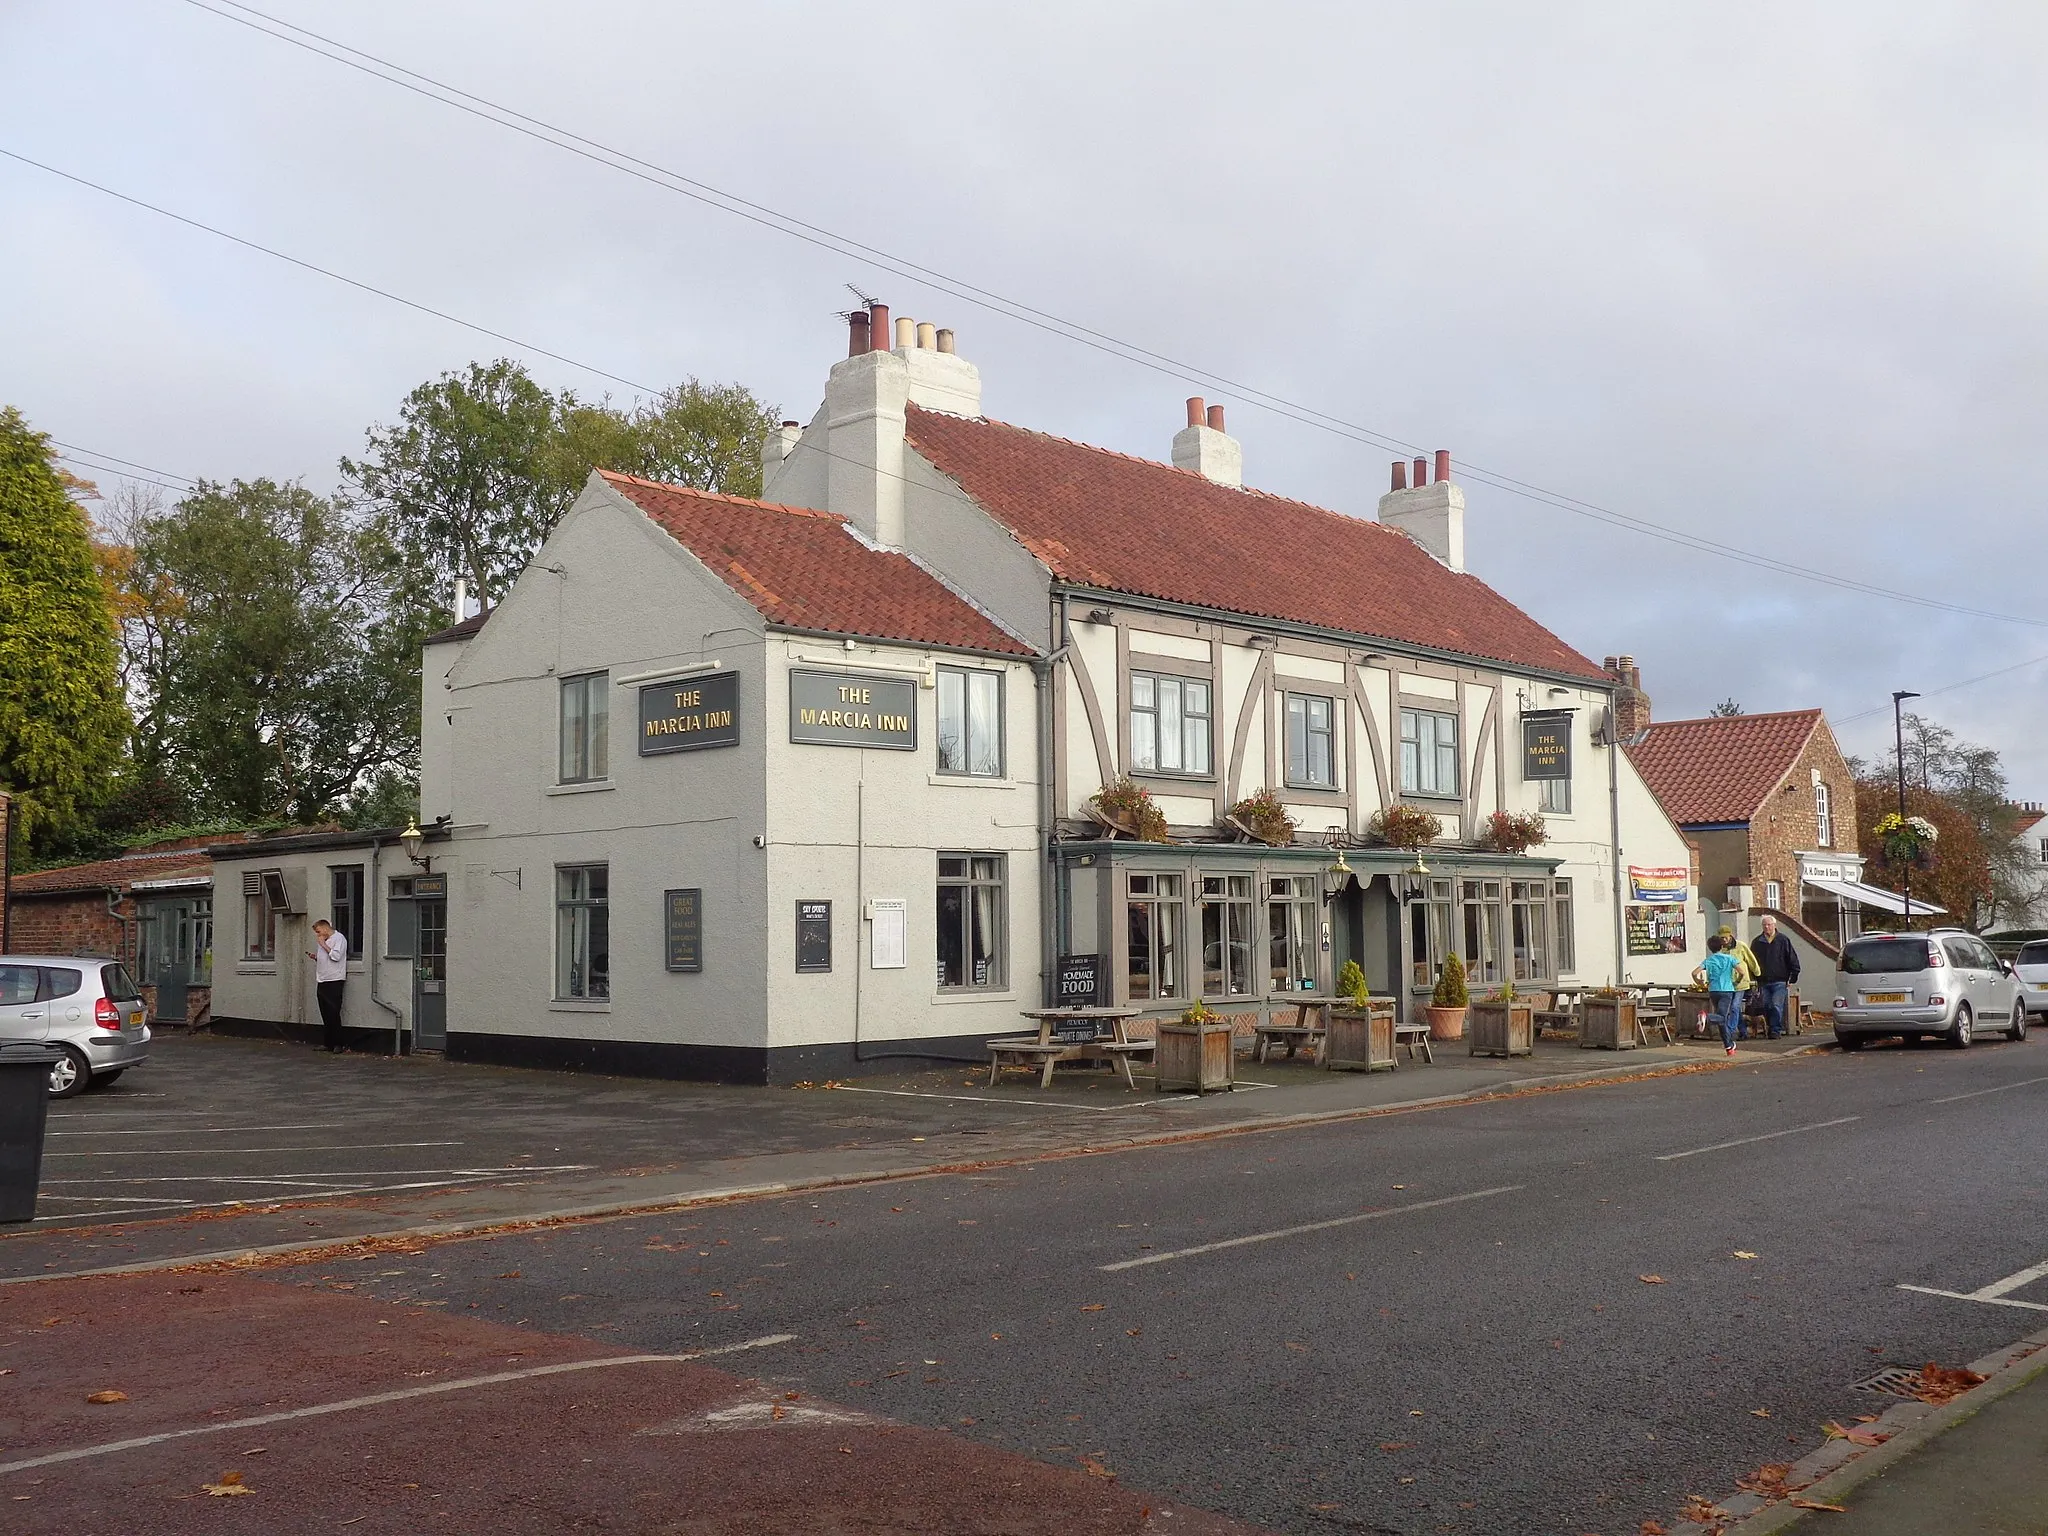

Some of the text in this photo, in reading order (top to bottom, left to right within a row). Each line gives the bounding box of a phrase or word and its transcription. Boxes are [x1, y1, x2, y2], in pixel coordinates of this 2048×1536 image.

[675, 690, 700, 709] THE
[838, 686, 871, 705] THE
[646, 710, 731, 737] MARCIA INN
[800, 708, 908, 732] MARCIA INN
[1538, 735, 1555, 744] THE
[1529, 745, 1565, 755] MARCIA
[1538, 757, 1555, 765] INN
[1830, 868, 1838, 877] Sons
[673, 897, 693, 907] GREAT
[674, 906, 693, 916] FOOD
[1063, 970, 1094, 980] HOMEMADE
[1061, 980, 1094, 994] FOOD
